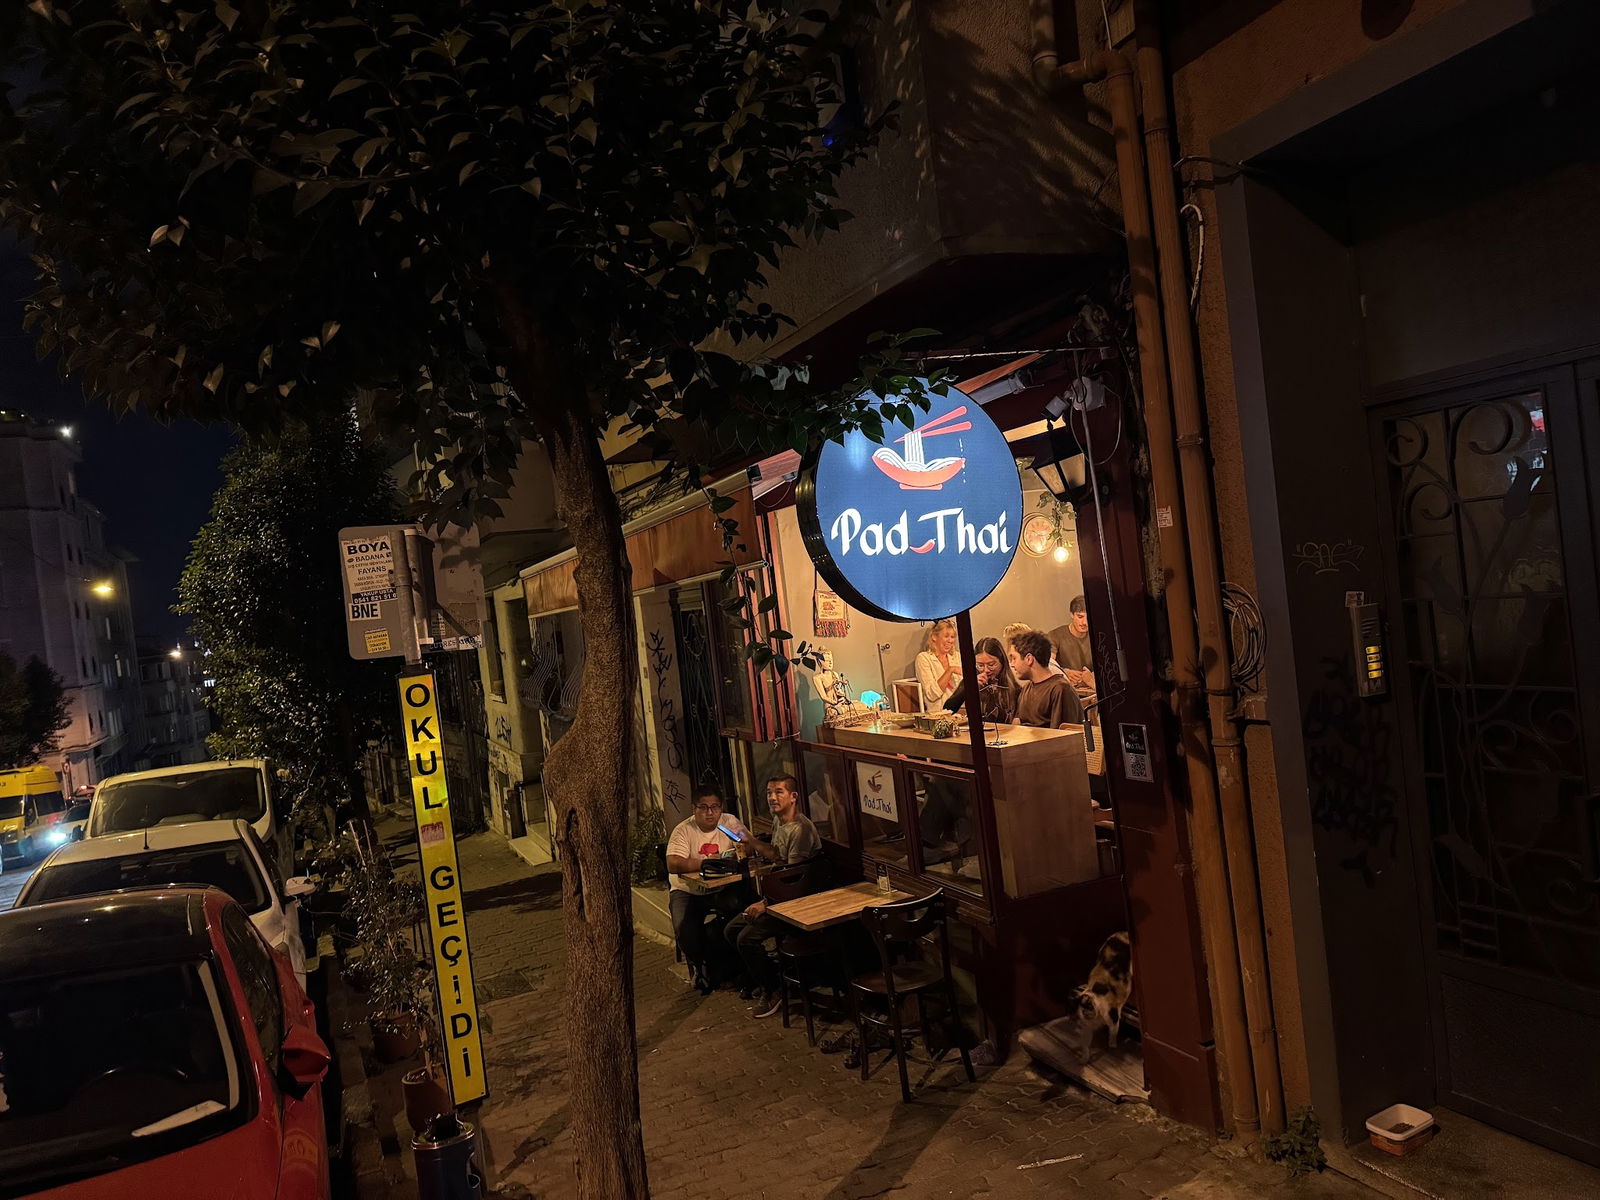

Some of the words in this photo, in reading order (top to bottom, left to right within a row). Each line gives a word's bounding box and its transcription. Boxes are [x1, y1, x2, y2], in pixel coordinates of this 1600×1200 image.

[831, 508, 908, 556] Pad
[917, 507, 1013, 555] Thai
[347, 541, 390, 555] BOYA
[355, 553, 385, 562] BADANA
[358, 566, 387, 575] FAYANS
[351, 603, 378, 619] BNE
[405, 683, 443, 810] OKUL
